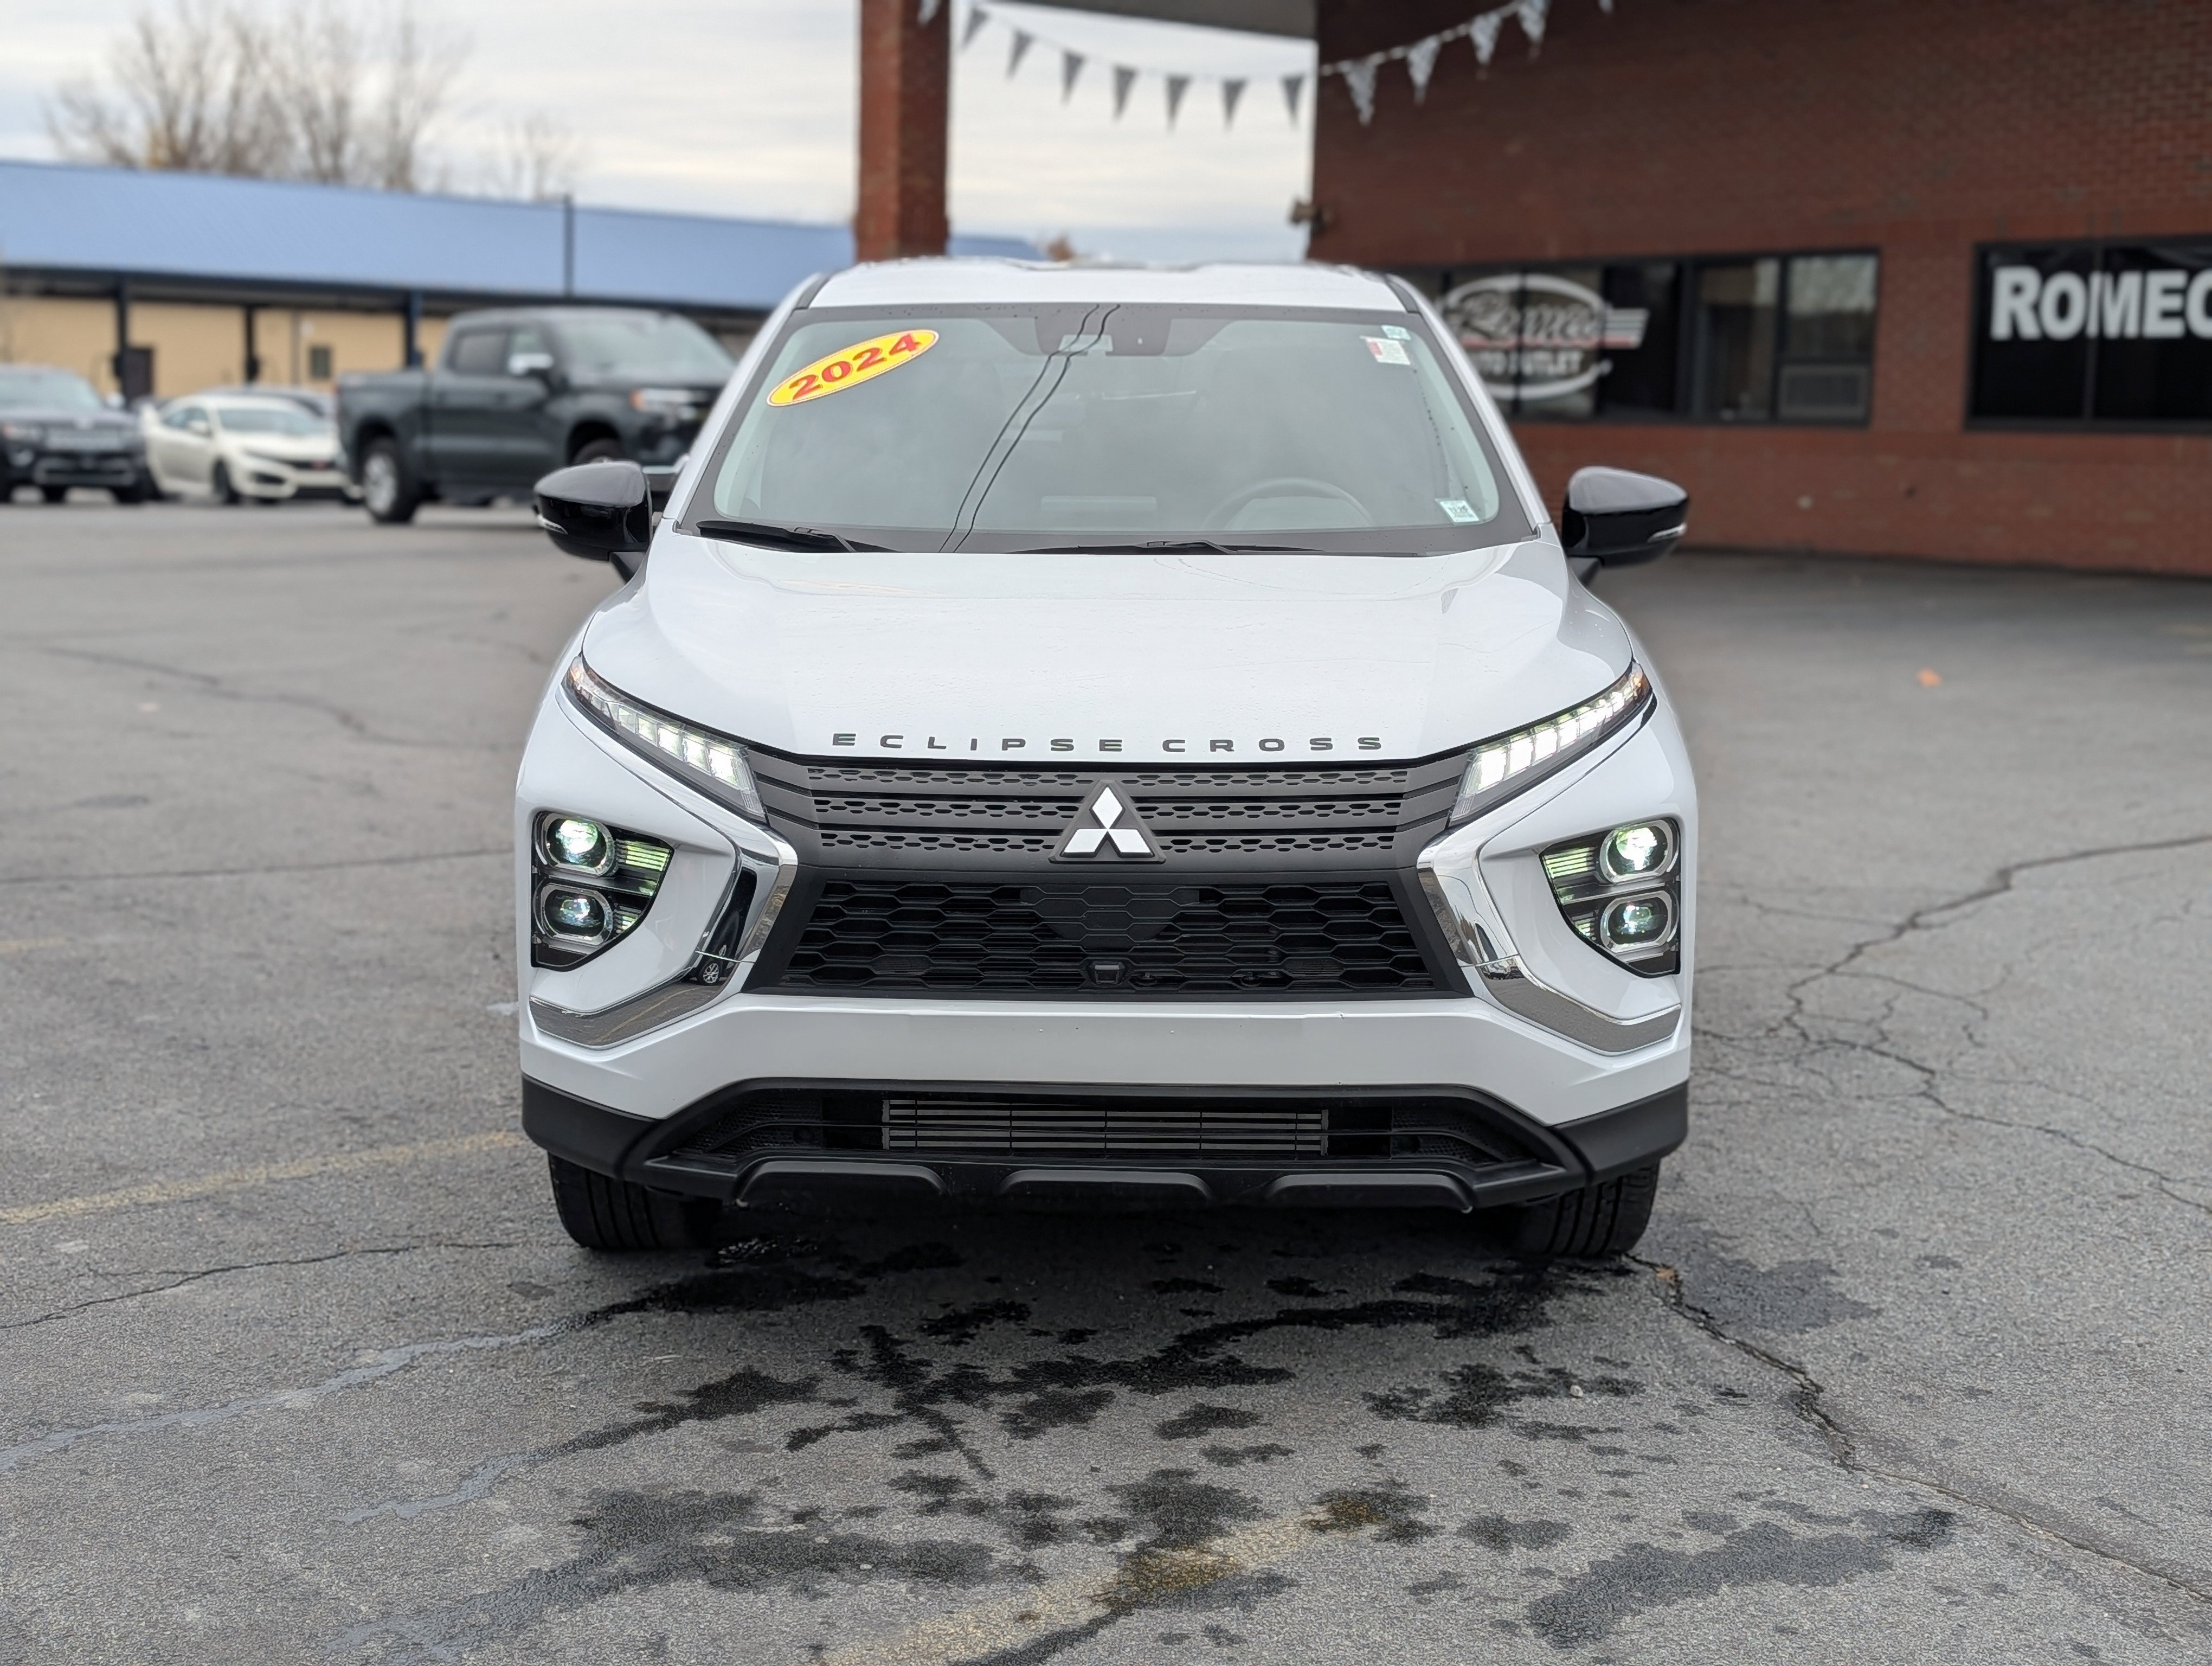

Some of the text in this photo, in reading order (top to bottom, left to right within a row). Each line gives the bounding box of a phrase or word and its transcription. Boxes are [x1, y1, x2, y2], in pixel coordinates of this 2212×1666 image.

[789, 334, 921, 401] 2024
[832, 733, 1382, 752] ECLIPSE CROSS
